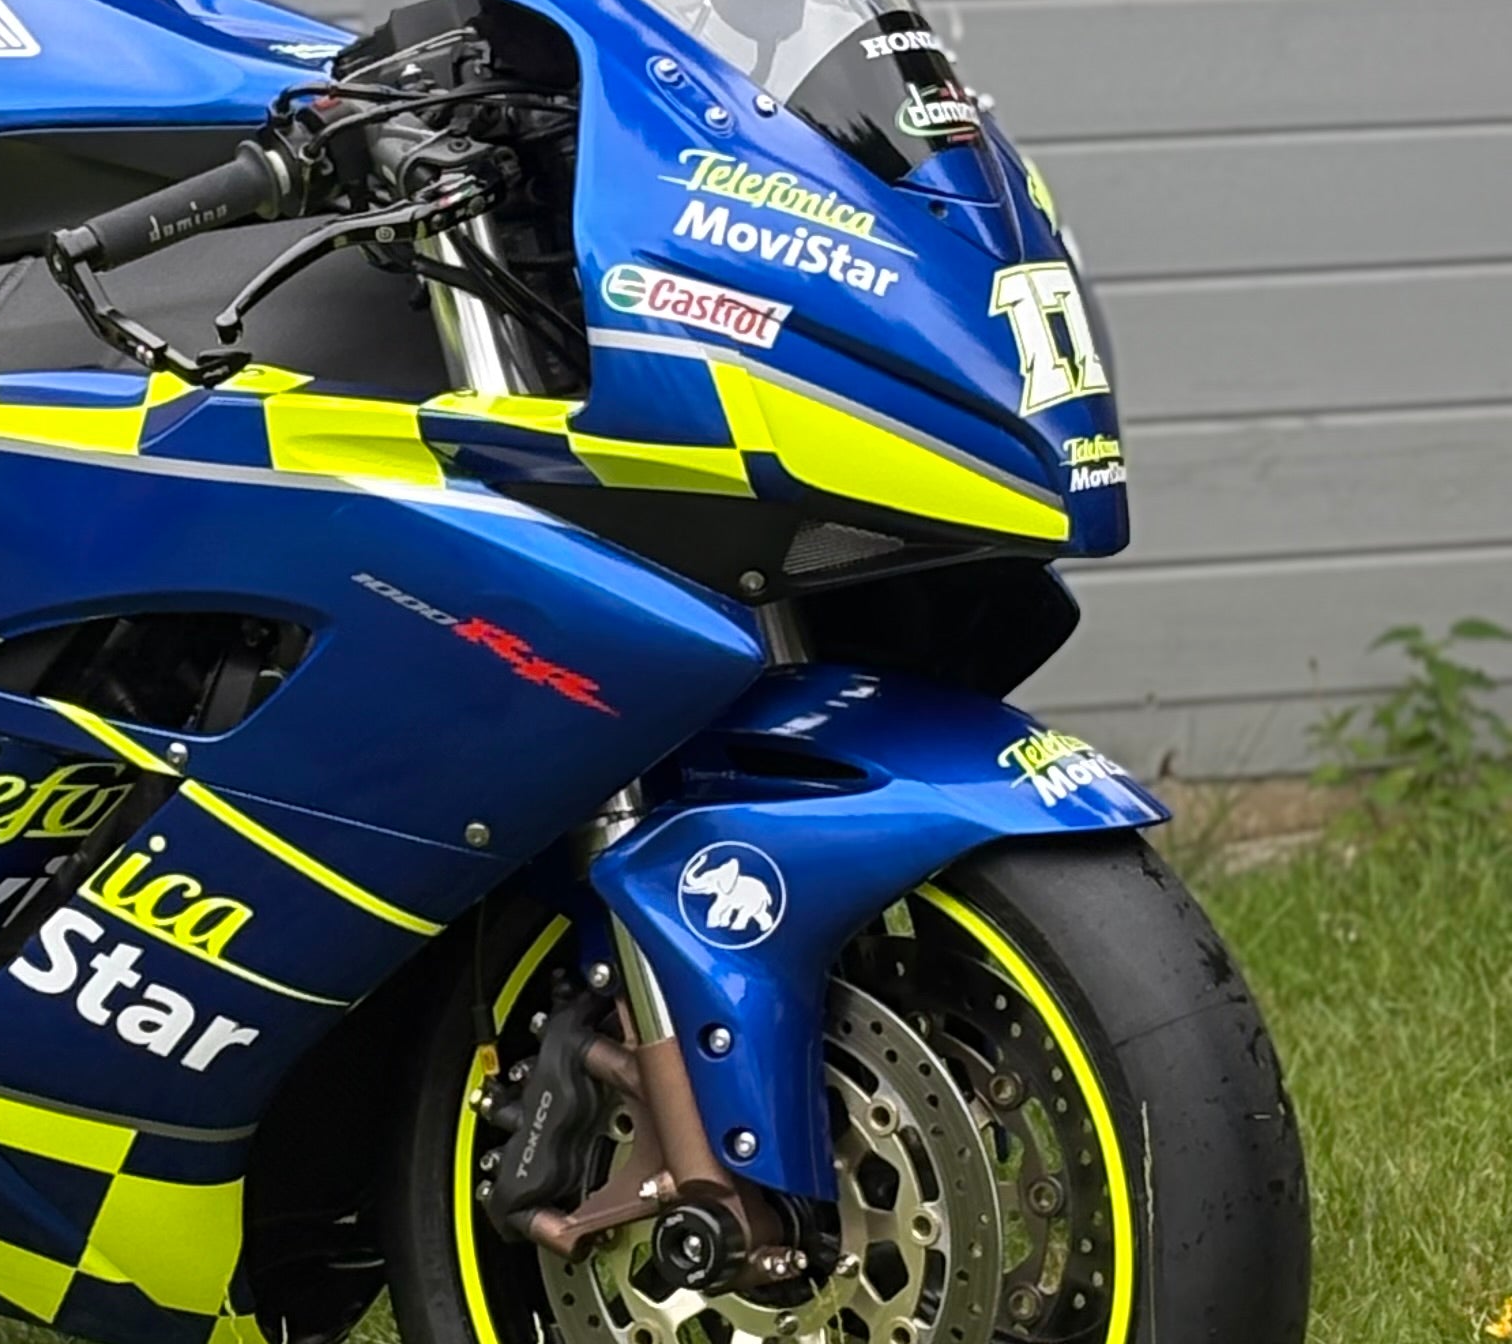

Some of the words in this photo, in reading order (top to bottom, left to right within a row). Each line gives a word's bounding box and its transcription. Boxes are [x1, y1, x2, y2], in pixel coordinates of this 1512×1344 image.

[673, 199, 899, 297] MoviStar
[648, 278, 776, 340] Castrol
[516, 1091, 552, 1179] TOKICO
